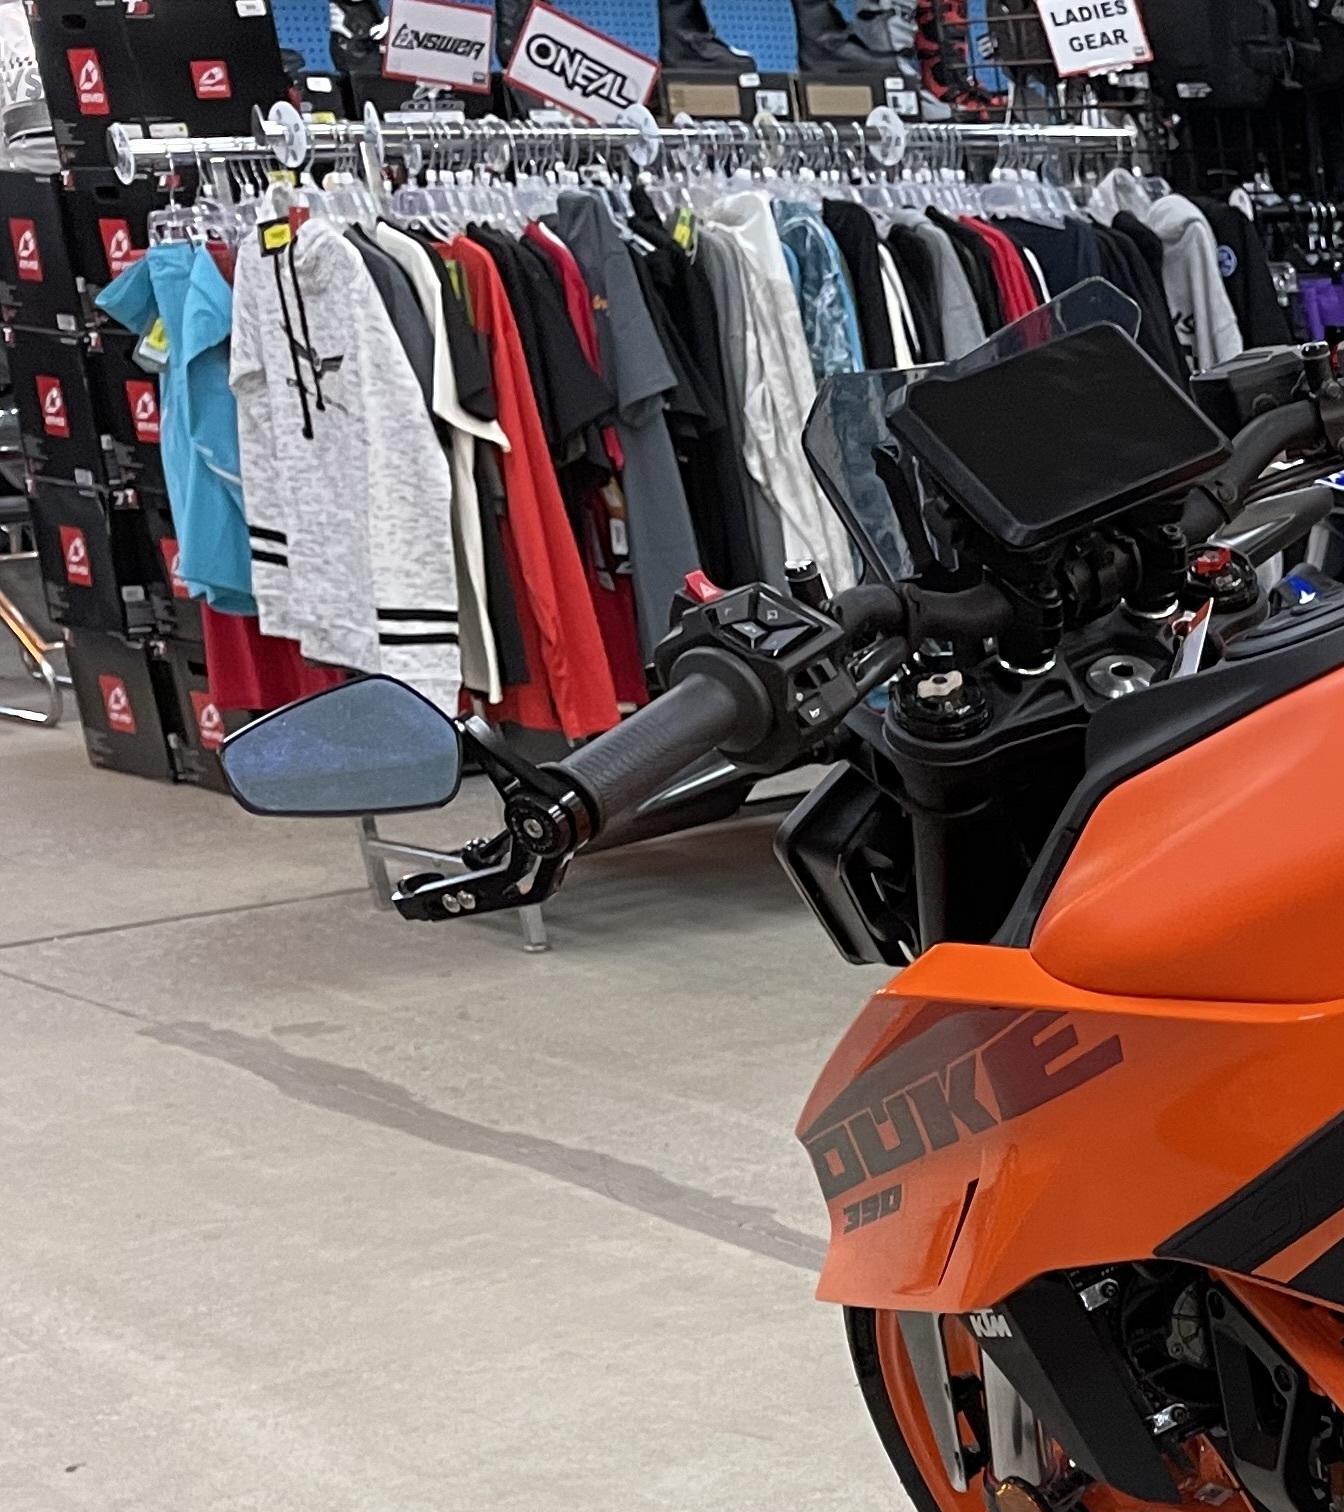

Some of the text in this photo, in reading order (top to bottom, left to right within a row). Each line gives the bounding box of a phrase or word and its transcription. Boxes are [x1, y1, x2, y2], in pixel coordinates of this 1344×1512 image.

[1050, 0, 1128, 27] LADIES
[392, 23, 486, 61] ANSWER
[1069, 29, 1129, 53] GEAR
[526, 33, 632, 110] ONEAL
[806, 1010, 1124, 1202] DUKE
[843, 1184, 903, 1234] 390
[969, 1308, 1013, 1338] KTM
